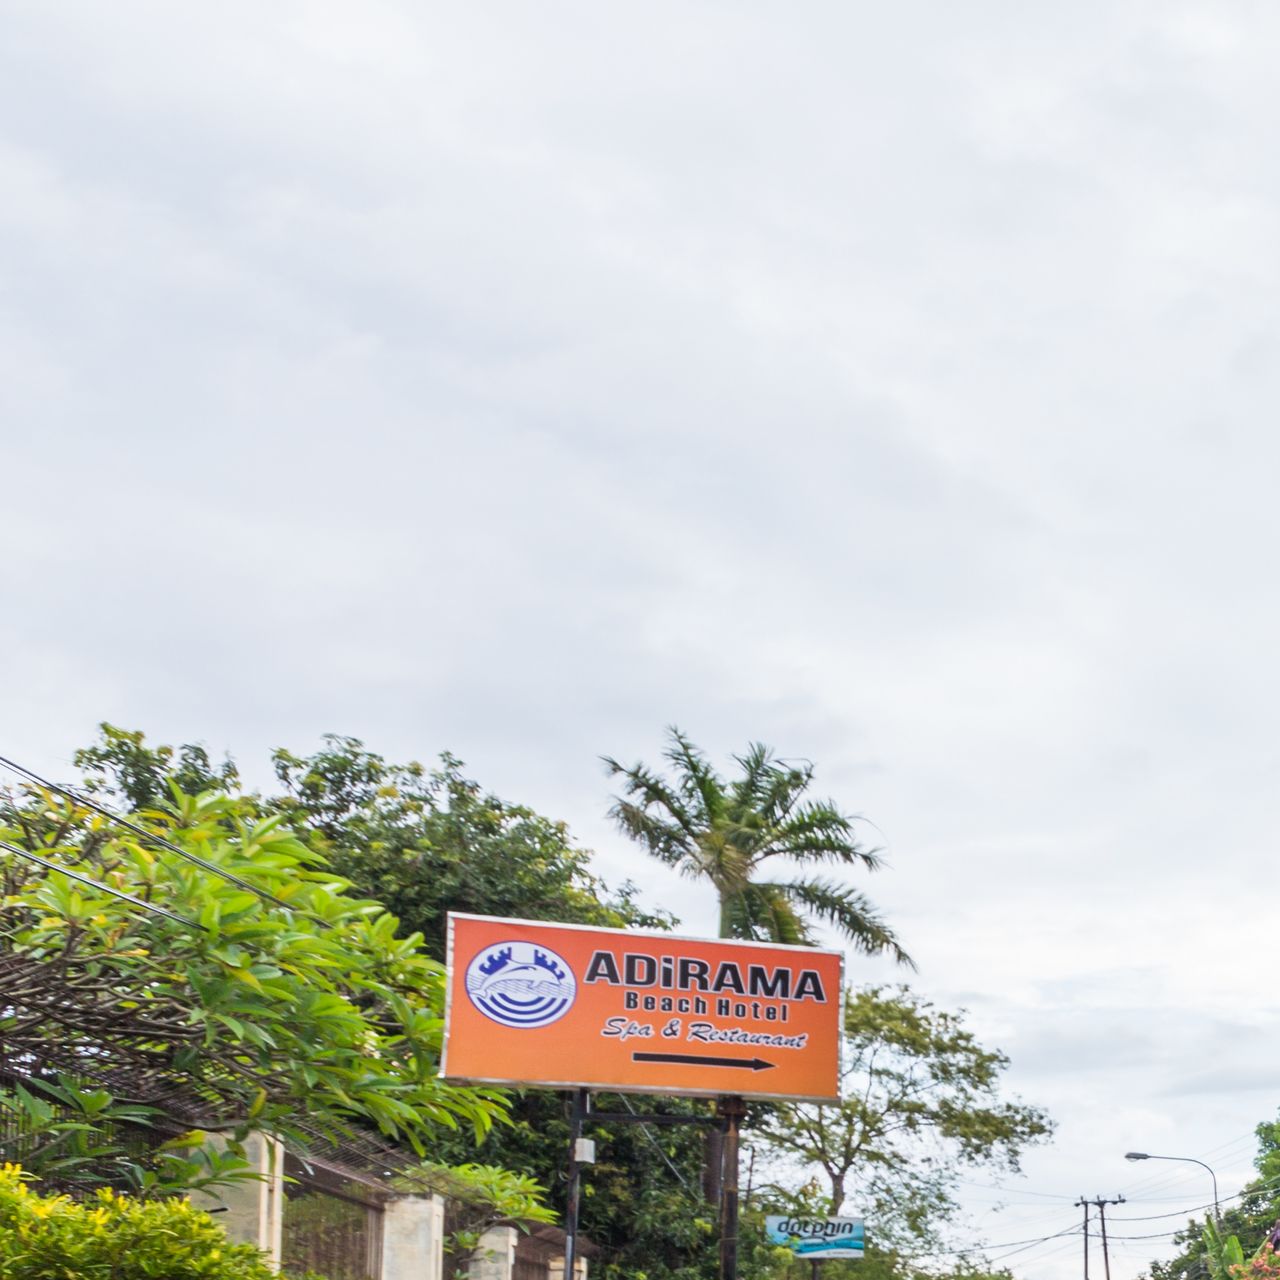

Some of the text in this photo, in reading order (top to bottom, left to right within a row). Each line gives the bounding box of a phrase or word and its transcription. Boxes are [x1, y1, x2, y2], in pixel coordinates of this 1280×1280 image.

[624, 991, 788, 1023] Beach Hotel
[601, 1017, 809, 1049] Spa & Restaurant
